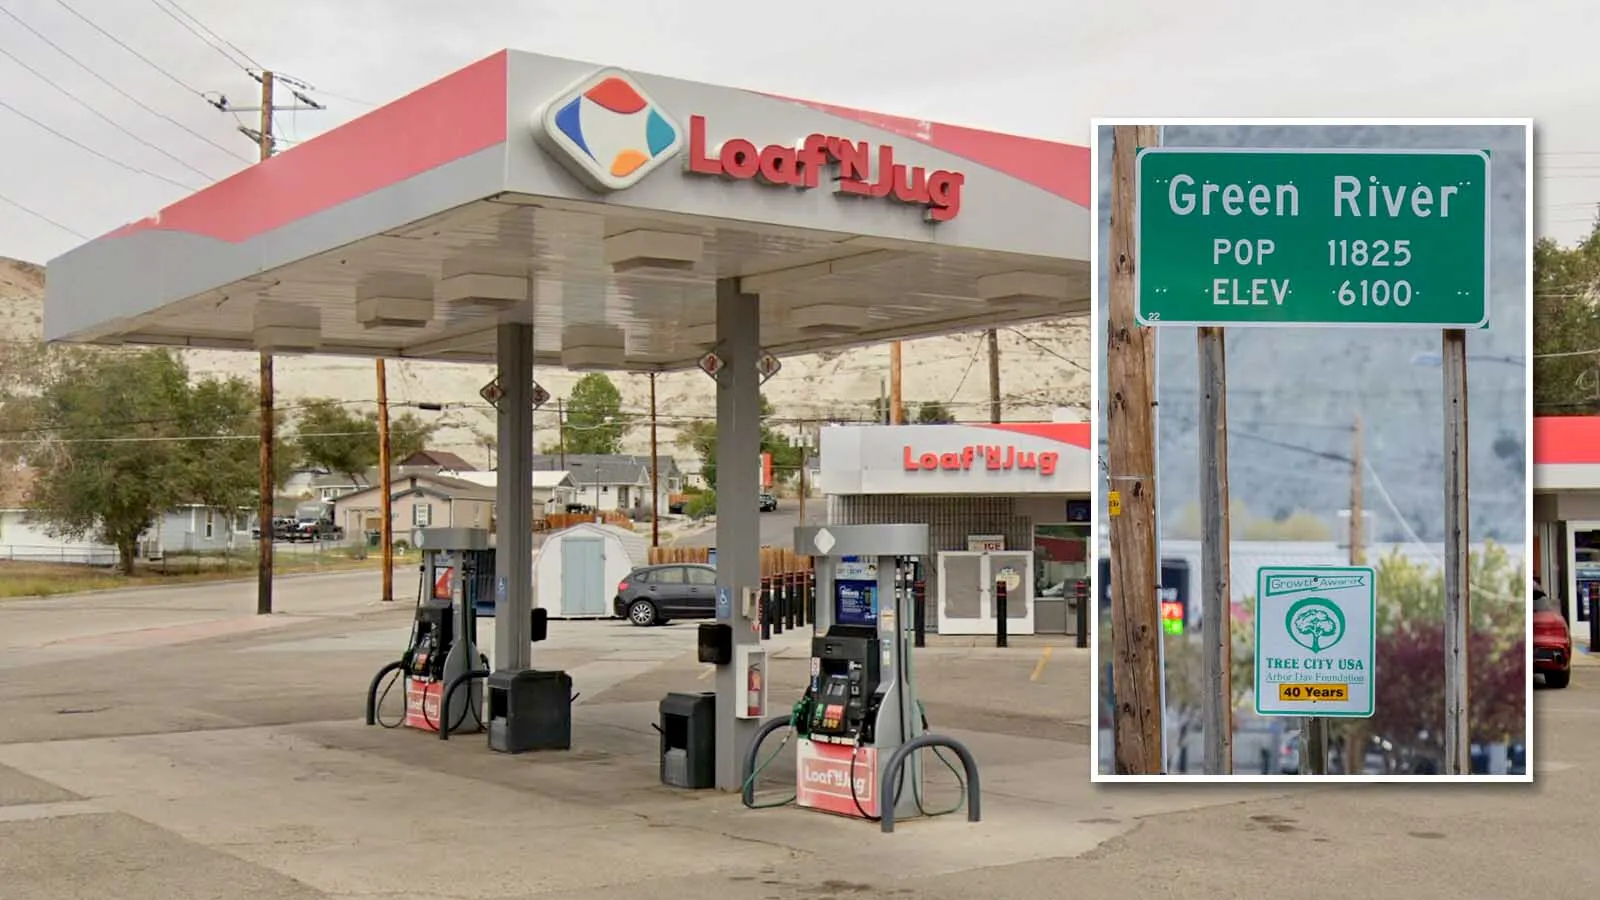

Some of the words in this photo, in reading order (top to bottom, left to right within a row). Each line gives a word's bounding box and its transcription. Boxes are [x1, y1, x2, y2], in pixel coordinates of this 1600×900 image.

[846, 144, 965, 222] Jug
[1168, 174, 1300, 217] Green
[1333, 175, 1459, 218] River
[1212, 238, 1276, 265] POP
[1327, 239, 1412, 267] 11825
[1212, 278, 1290, 305] ELEV
[1337, 279, 1413, 307] 6100
[1002, 445, 1059, 476] Jug
[1265, 657, 1300, 670] TREE
[1303, 657, 1334, 670] CITY
[1338, 657, 1364, 671] USA
[1283, 686, 1301, 697] 40
[1304, 686, 1345, 698] Years
